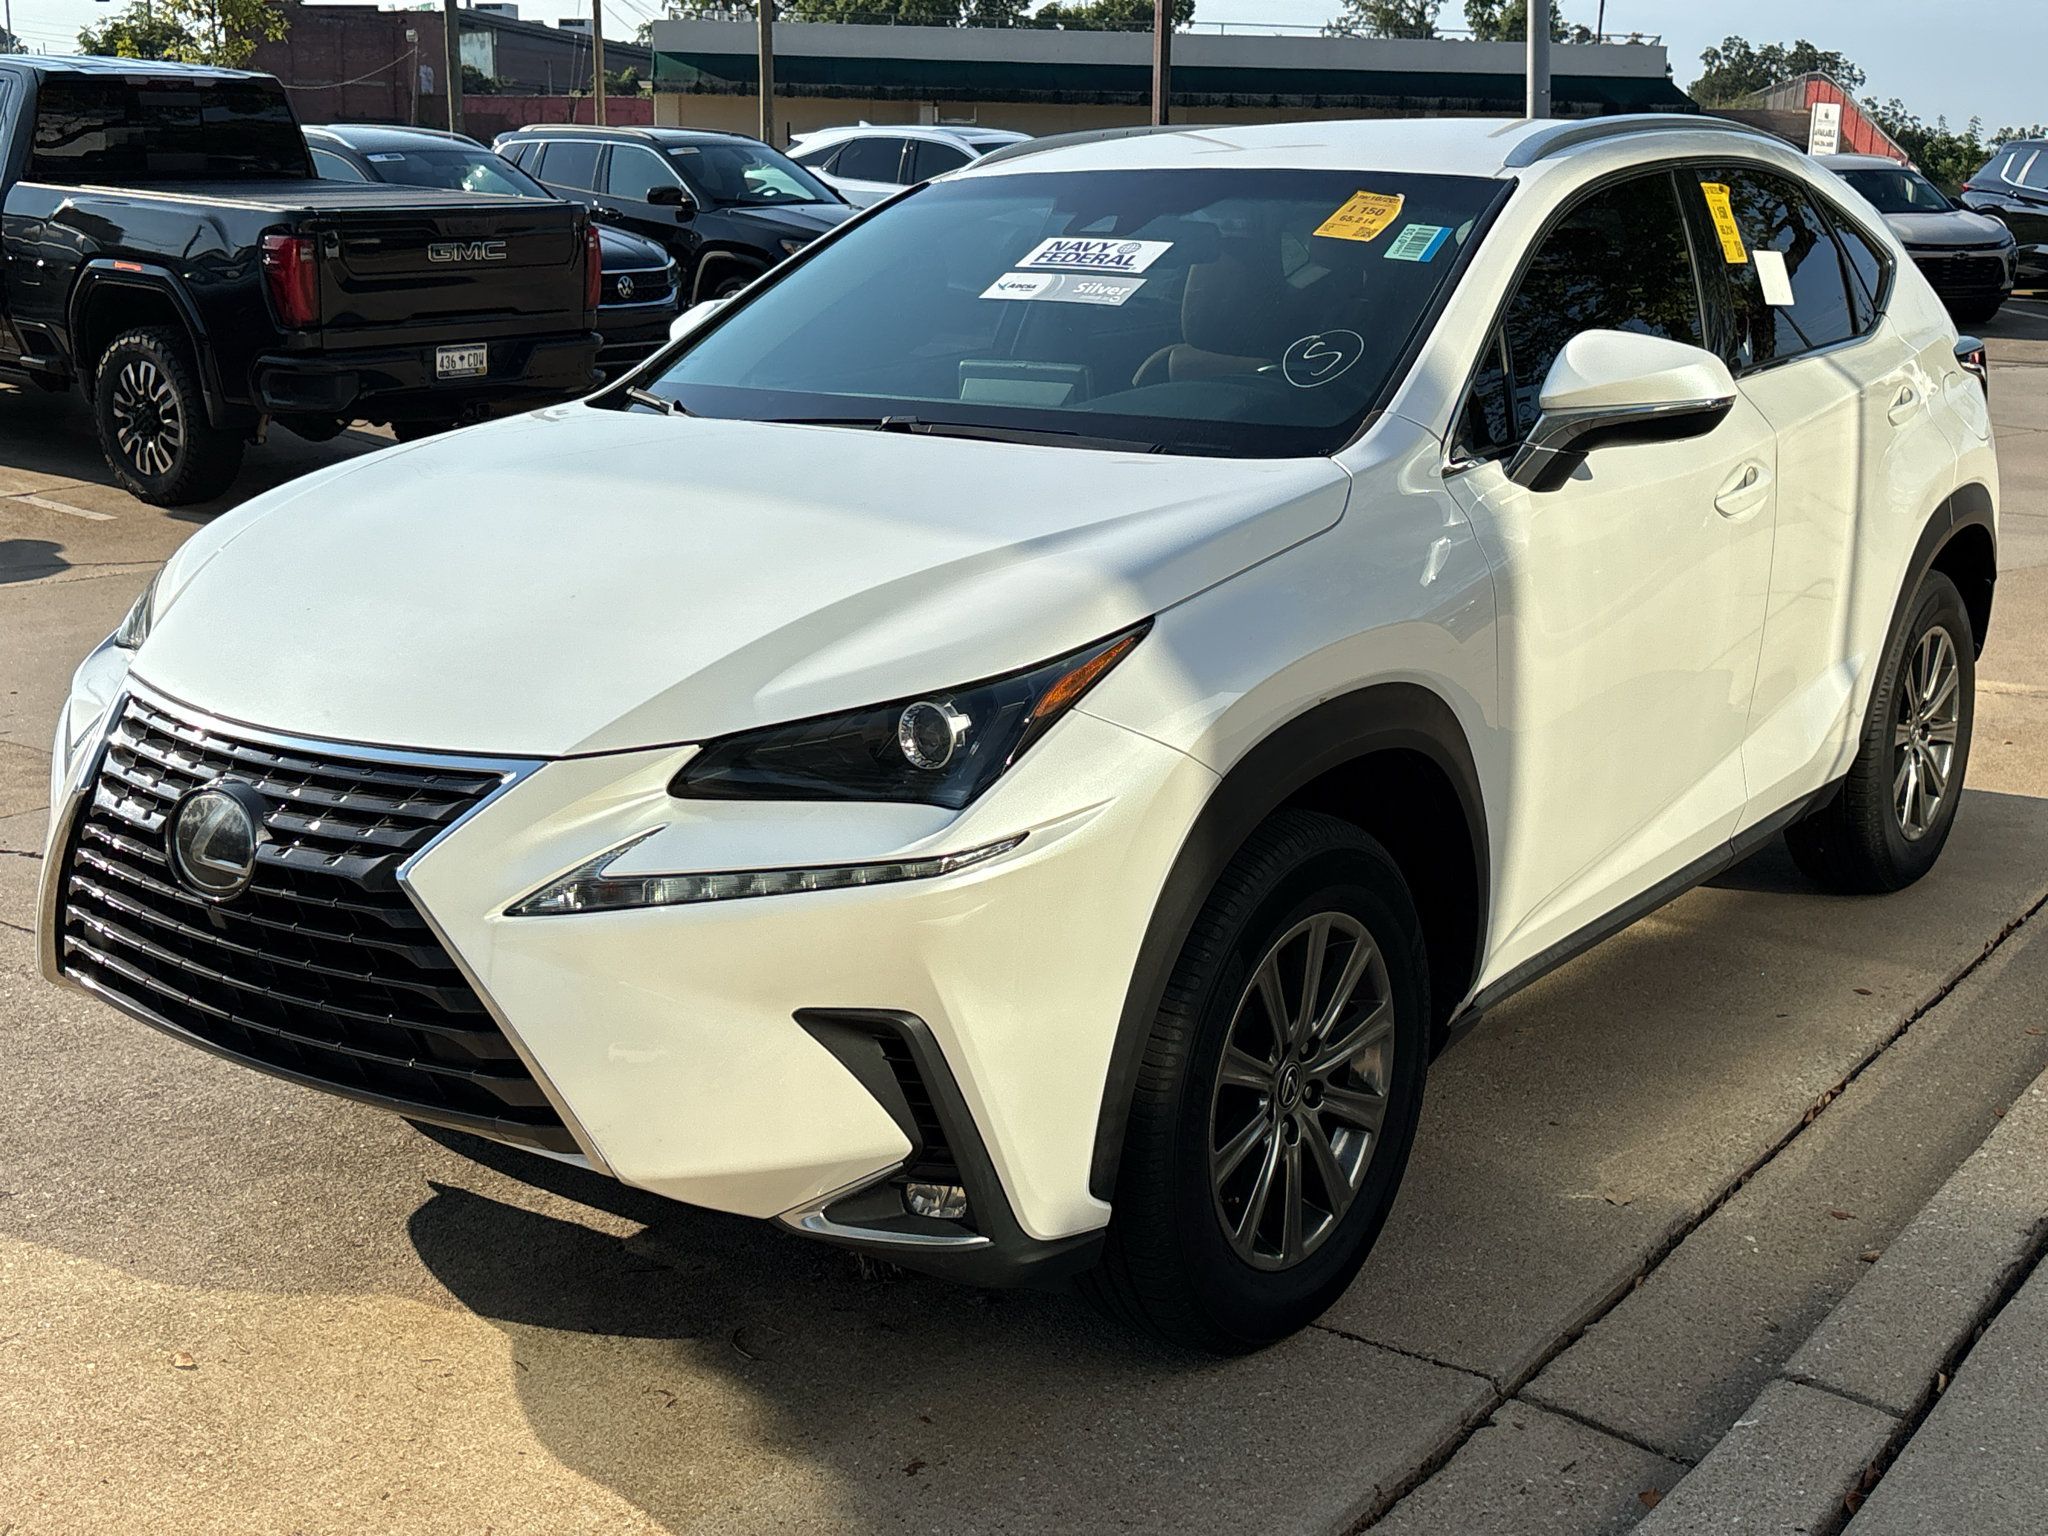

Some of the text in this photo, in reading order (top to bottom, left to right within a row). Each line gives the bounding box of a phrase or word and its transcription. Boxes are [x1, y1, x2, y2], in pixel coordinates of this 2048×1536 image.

[1360, 206, 1386, 216] 150
[427, 240, 507, 262] GMC
[1047, 241, 1120, 253] NAVY
[1033, 252, 1138, 267] FEDERAL
[1072, 282, 1132, 296] Silver
[439, 351, 485, 371] 436 CDW
